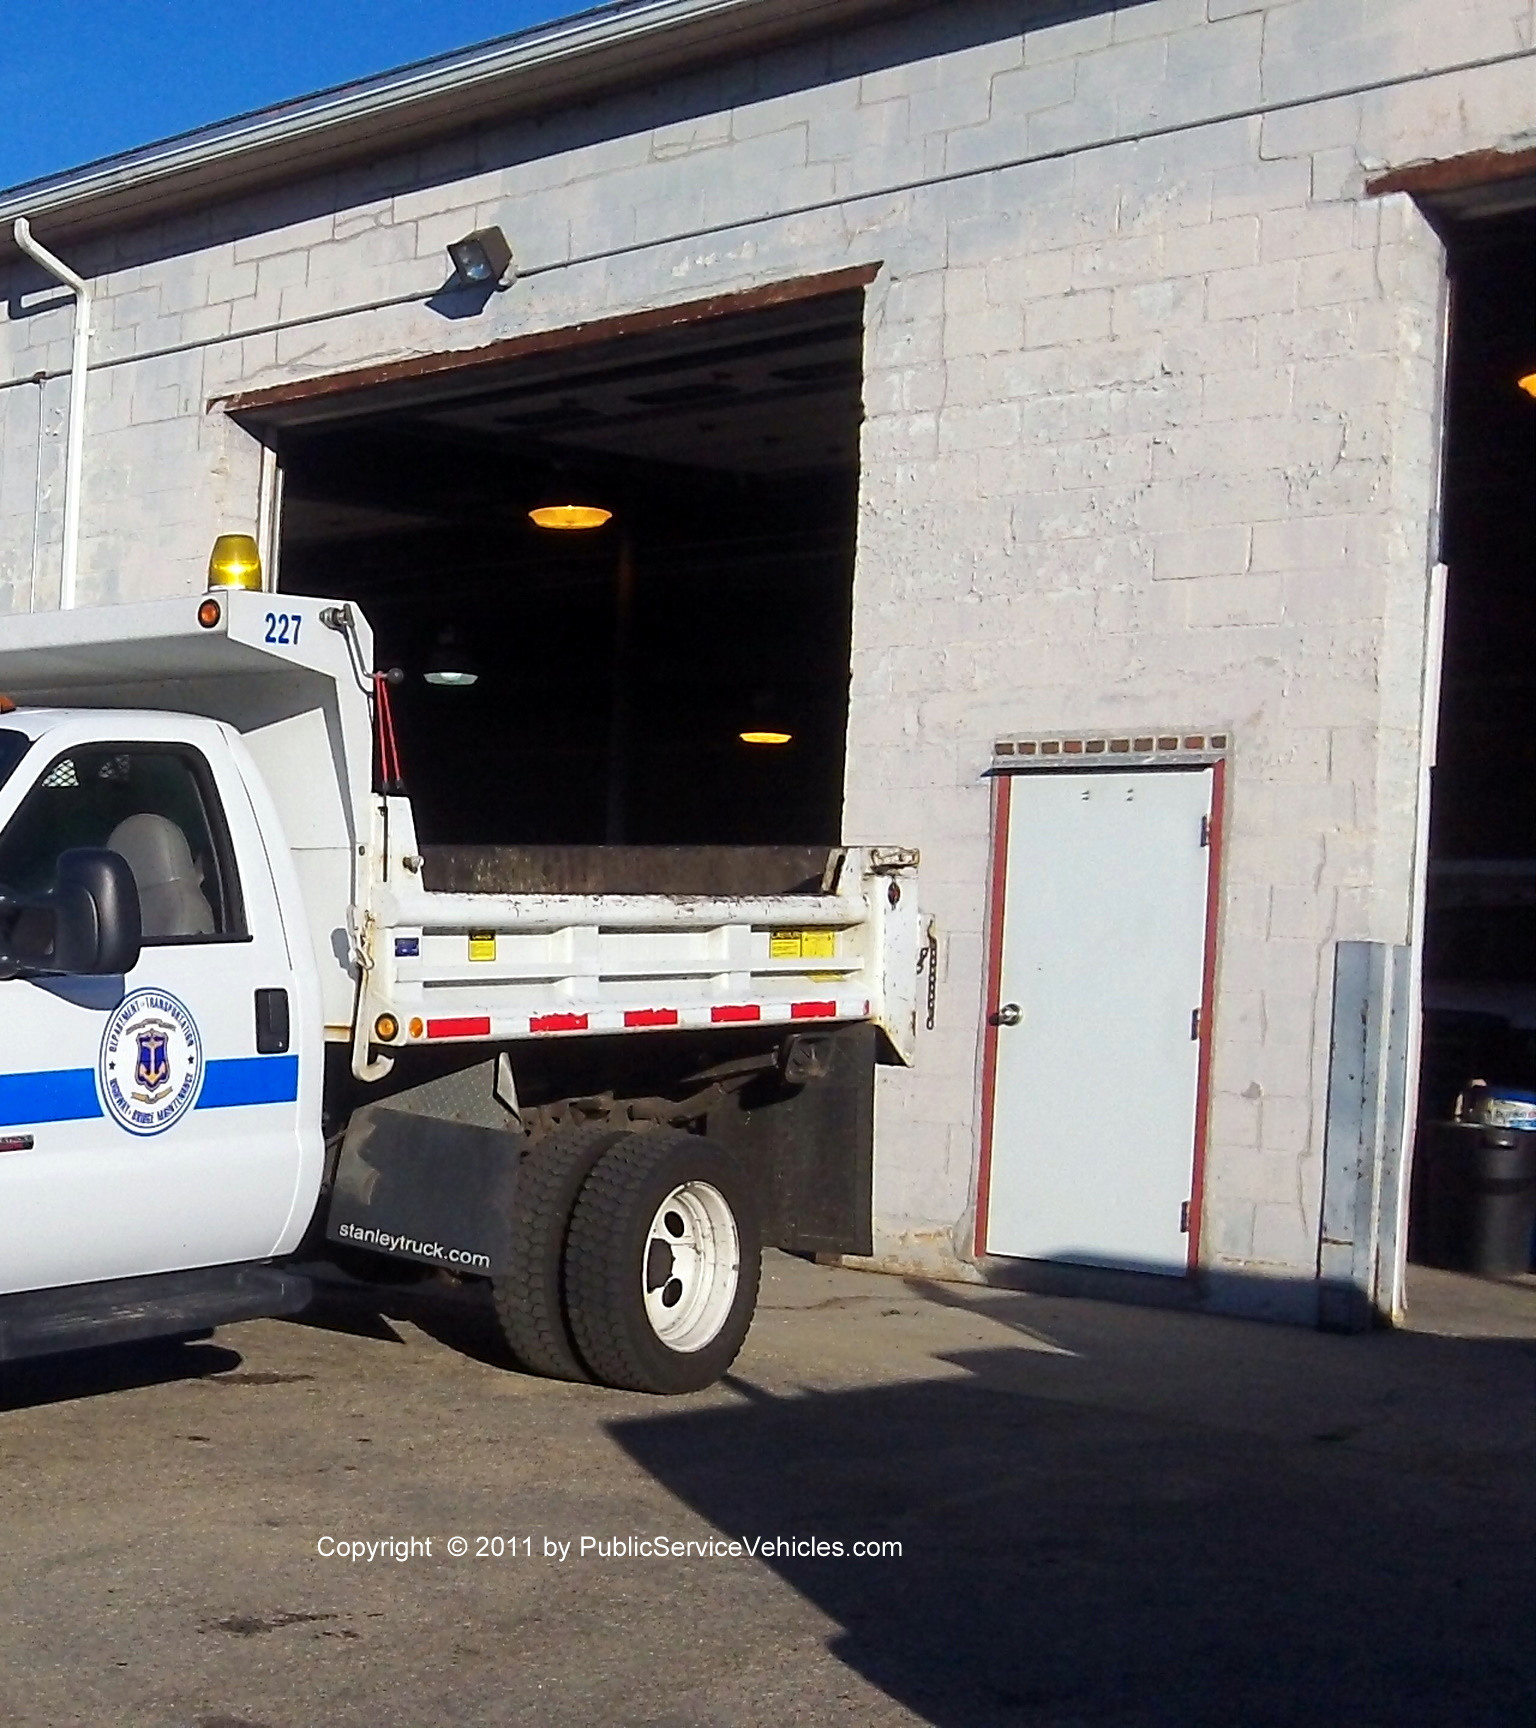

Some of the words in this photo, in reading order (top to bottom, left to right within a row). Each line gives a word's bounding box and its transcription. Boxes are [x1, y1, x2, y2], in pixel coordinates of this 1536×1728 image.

[265, 612, 302, 645] 227
[109, 1001, 140, 1053] DEPARTMENT
[145, 997, 194, 1047] TRANSPORTATION
[339, 1223, 491, 1268] stanleytruck.com
